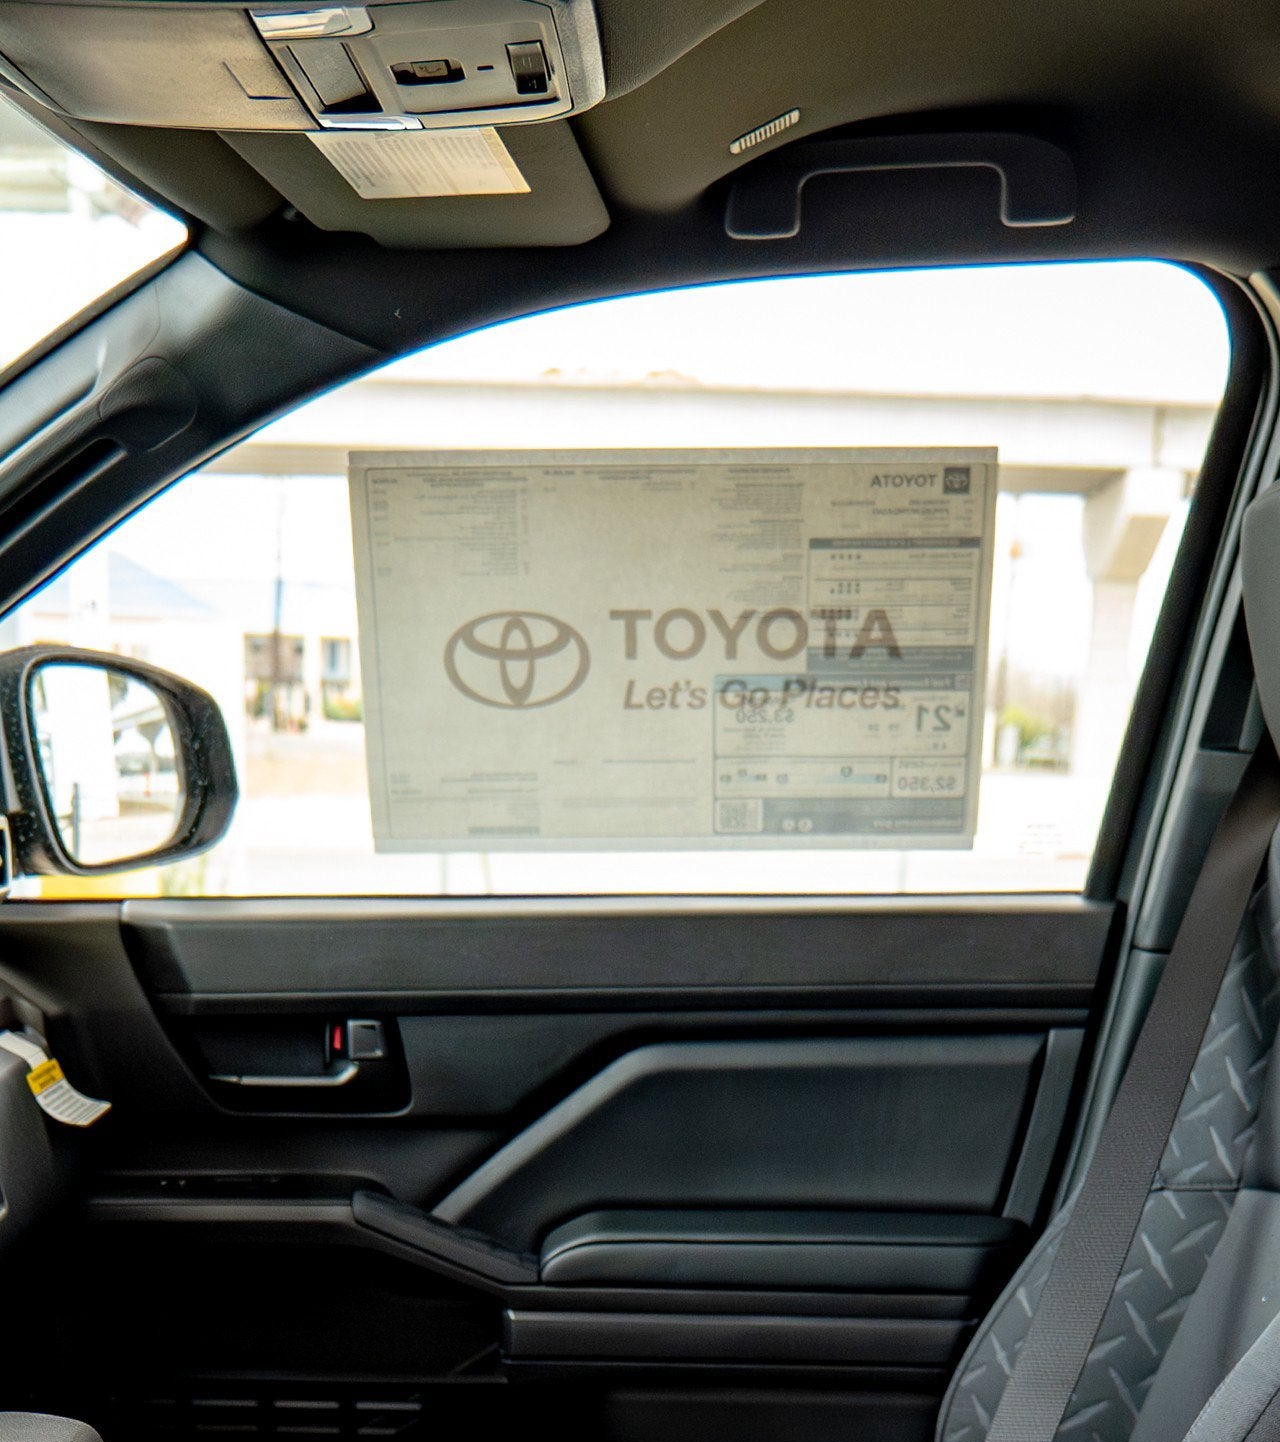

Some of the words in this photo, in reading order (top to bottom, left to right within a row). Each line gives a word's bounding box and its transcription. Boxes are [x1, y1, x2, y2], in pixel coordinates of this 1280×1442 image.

[609, 607, 902, 661] TOYOTA
[623, 679, 707, 711] Let's
[720, 679, 770, 710] Go
[780, 677, 903, 710] Places
